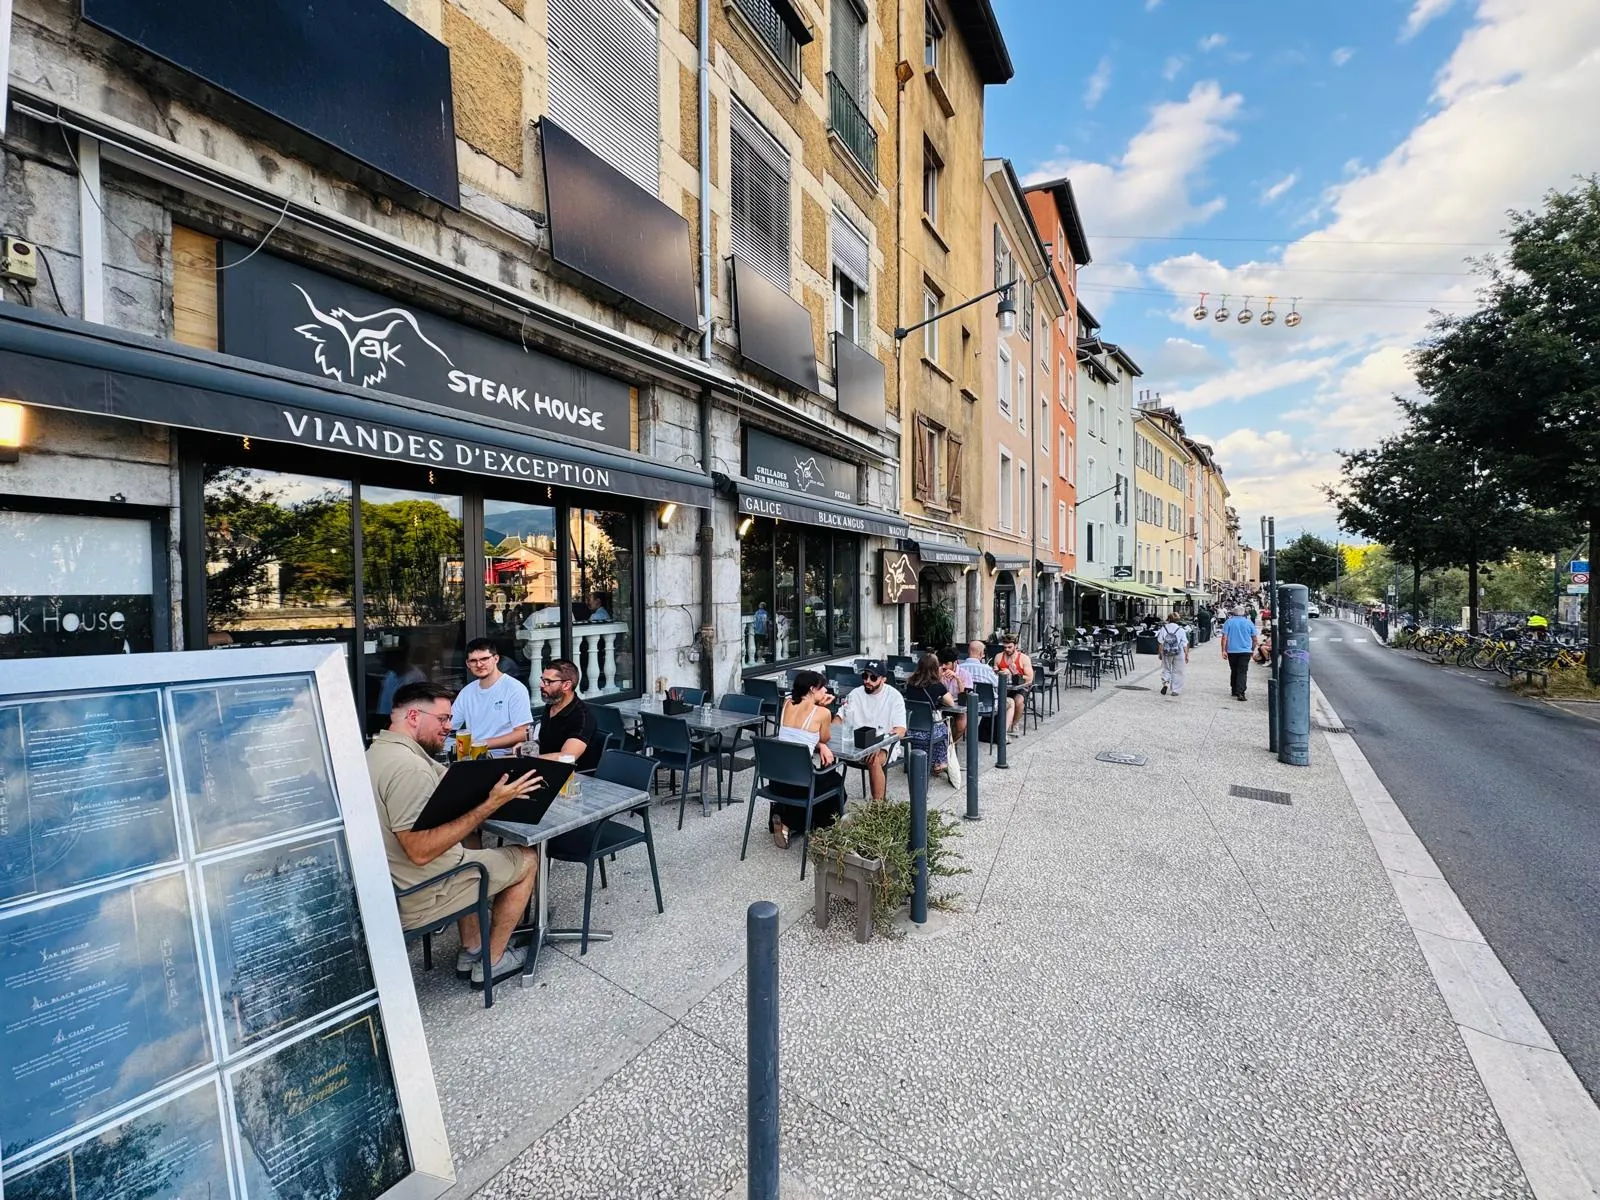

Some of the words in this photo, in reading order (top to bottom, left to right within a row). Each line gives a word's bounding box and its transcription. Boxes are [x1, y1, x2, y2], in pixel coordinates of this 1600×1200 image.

[447, 369, 531, 412] STEAK
[534, 391, 606, 431] HOUSE
[282, 410, 445, 462] VIANDES
[455, 444, 610, 487] D'EXCEPTION
[753, 474, 766, 483] SUR
[766, 476, 790, 489] BRAISES
[756, 466, 788, 480] GRILLADES
[745, 497, 782, 515] GALICE
[818, 511, 842, 527] BLACK
[842, 515, 865, 530] ANGUS
[42, 606, 126, 633] House
